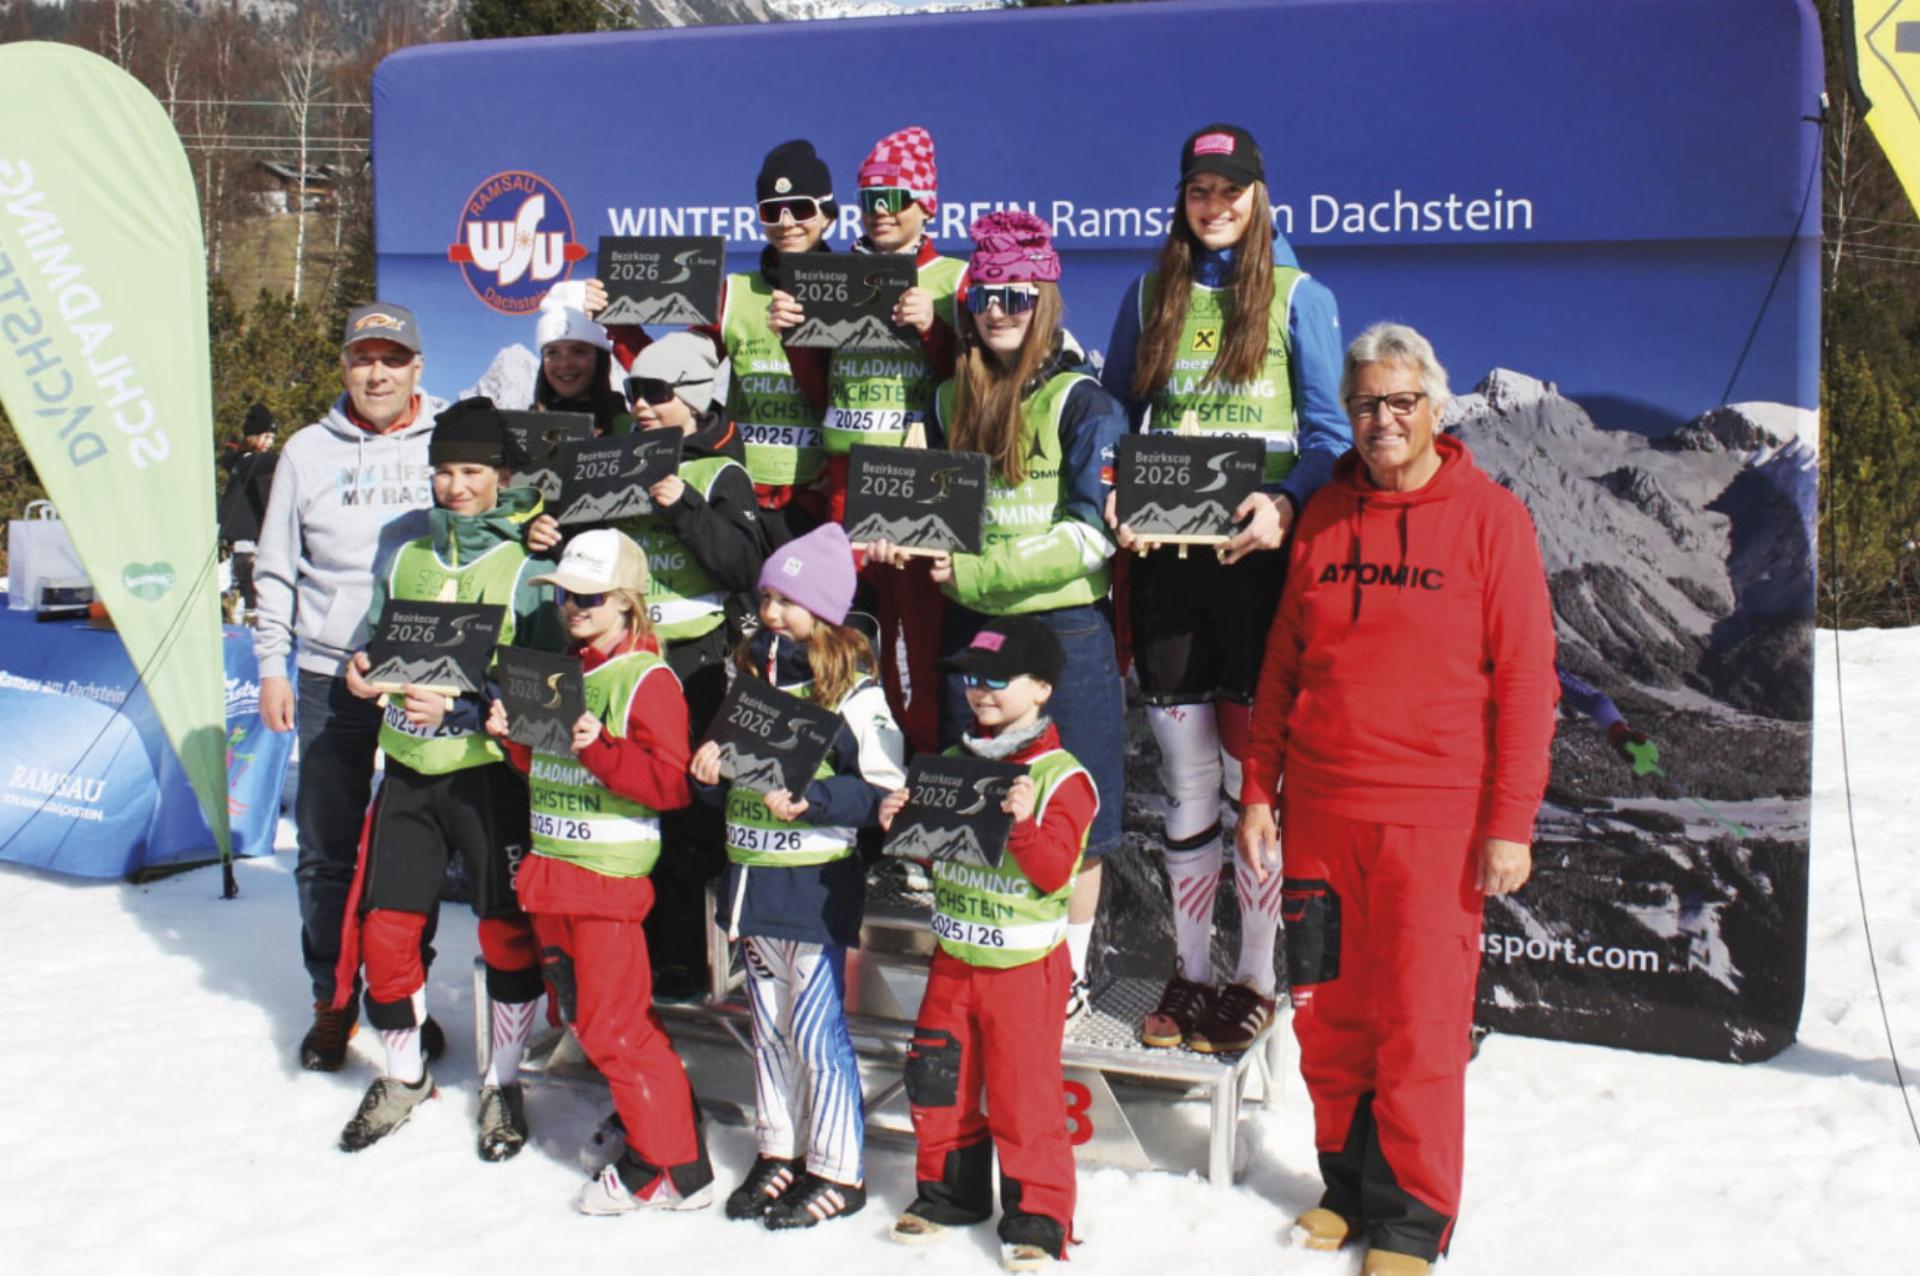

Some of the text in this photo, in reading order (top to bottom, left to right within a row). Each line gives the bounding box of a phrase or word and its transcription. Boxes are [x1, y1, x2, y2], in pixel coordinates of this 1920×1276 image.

[470, 176, 537, 216] RAMSAU
[1052, 200, 1176, 238] Ramsa
[1311, 189, 1533, 234] Dachstein
[611, 251, 660, 263] Bezirkscup
[610, 264, 659, 280] 2026
[794, 270, 848, 282] Bezirkscup
[795, 283, 849, 302] 2026
[743, 425, 793, 445] 2025
[1135, 451, 1192, 466] Bezirkscup
[574, 459, 620, 480] 2026
[862, 462, 916, 478] Bezirkscup
[1133, 465, 1191, 486] 2026
[341, 487, 375, 506] MY
[860, 476, 915, 498] 2026
[1318, 562, 1445, 591] ATOMIC
[386, 624, 436, 642] 2026
[508, 677, 541, 701] 2026
[728, 705, 775, 737] 2026
[911, 785, 959, 809] 2026
[565, 820, 592, 840] 26
[773, 830, 802, 851] 26
[977, 925, 1005, 948] 26
